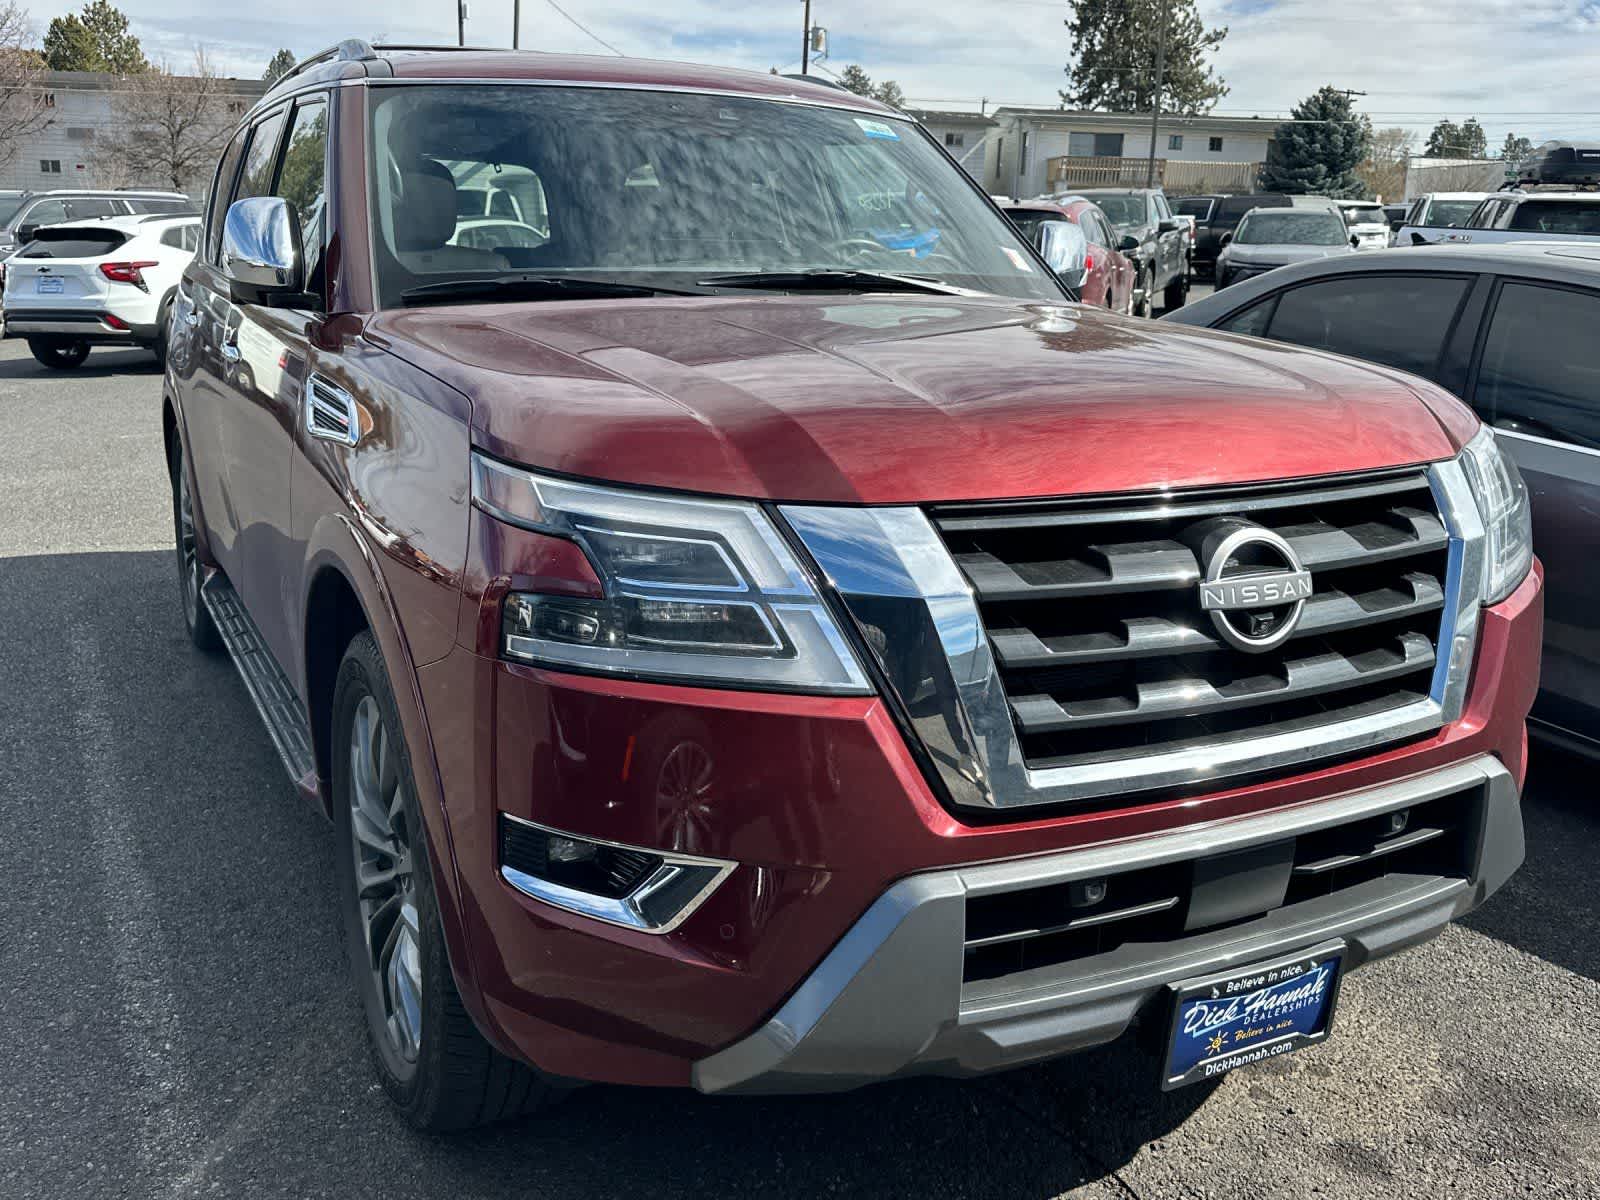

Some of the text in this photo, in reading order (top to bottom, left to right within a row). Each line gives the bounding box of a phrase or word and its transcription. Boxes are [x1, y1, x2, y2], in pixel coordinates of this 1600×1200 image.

[1205, 579, 1311, 606] NISSAN
[1226, 965, 1303, 993] Believe in nice.
[1184, 969, 1329, 1034] Dick Hannah
[1243, 995, 1321, 1025] DEALERSHIPS
[1234, 1027, 1264, 1042] Believe
[1266, 1025, 1274, 1033] in
[1205, 1041, 1293, 1076] DickHannah.com
